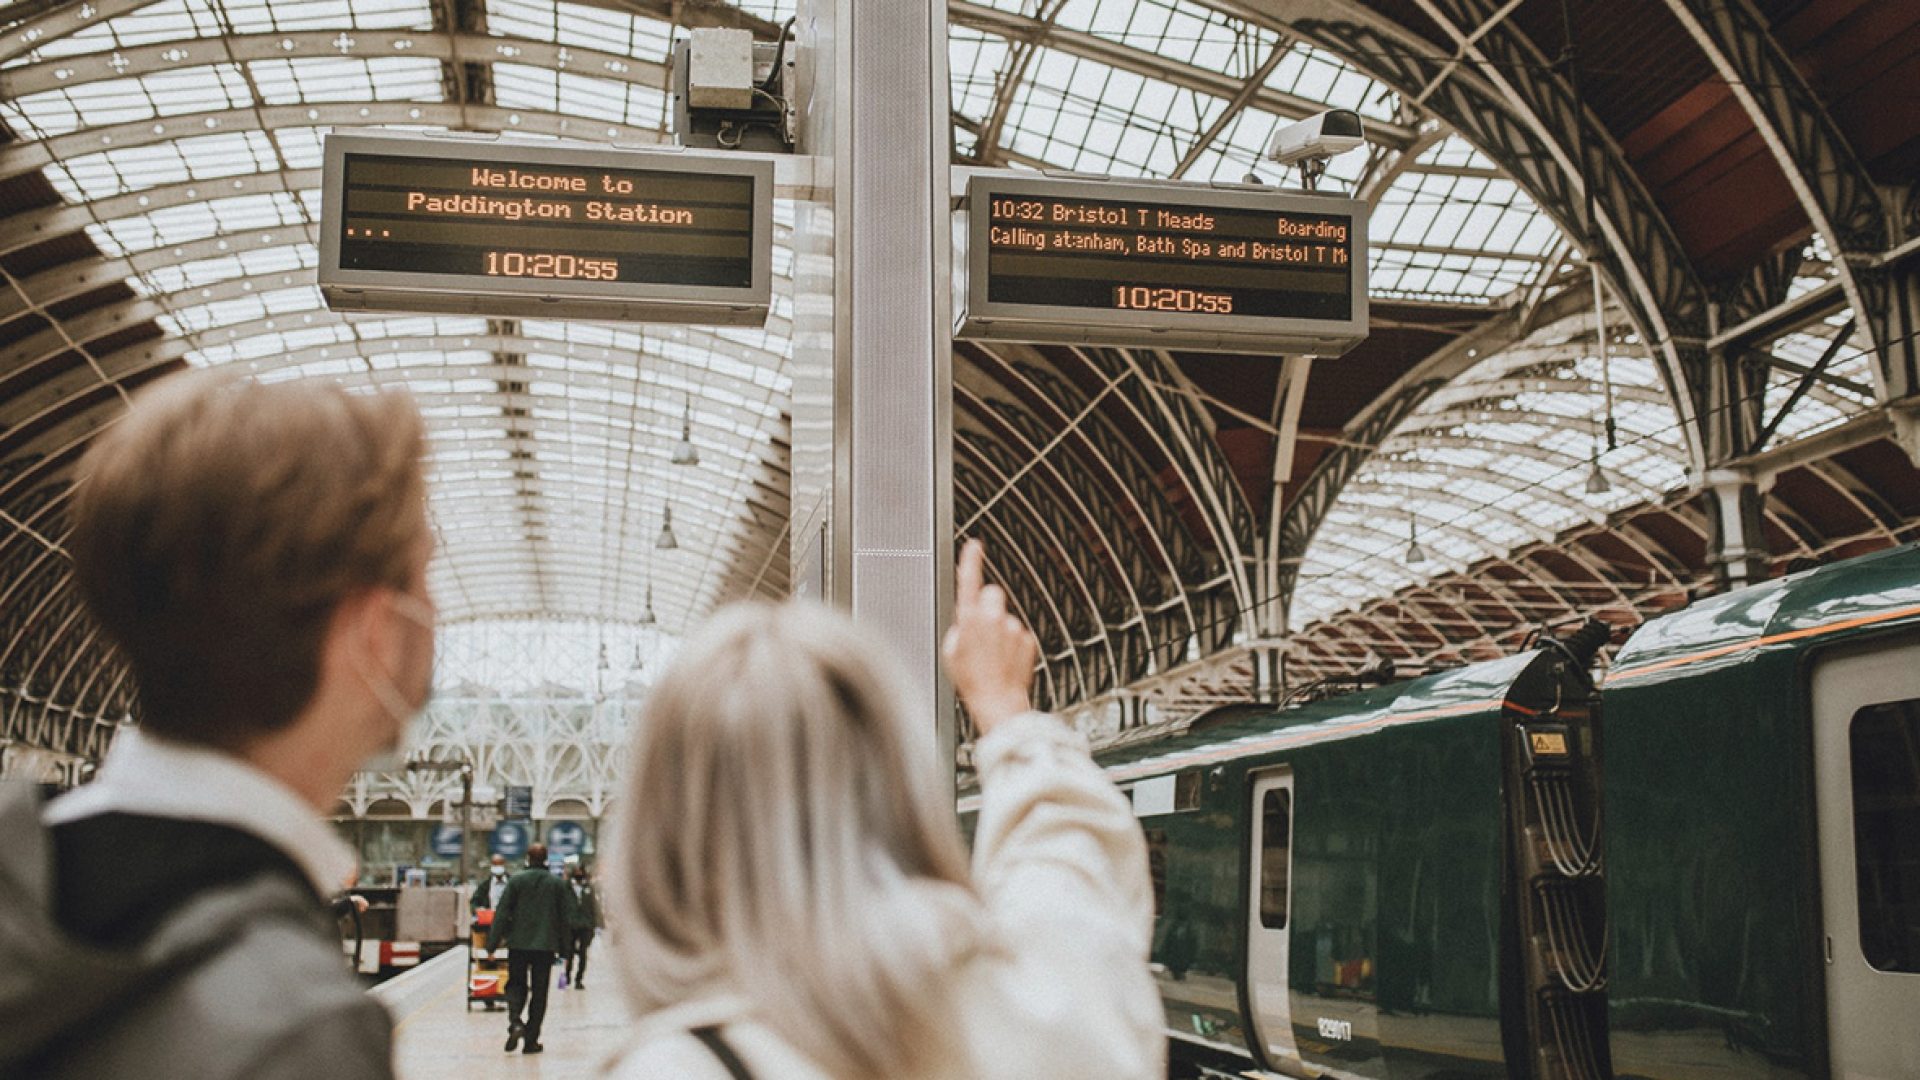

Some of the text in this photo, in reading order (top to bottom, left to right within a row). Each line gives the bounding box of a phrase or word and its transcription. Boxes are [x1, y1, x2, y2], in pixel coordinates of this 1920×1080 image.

[470, 167, 634, 195] Welcome to
[407, 191, 694, 225] Paddington Station
[991, 200, 1214, 231] 10:32 Bristol T Meads
[990, 226, 1046, 251] Calling
[1136, 235, 1175, 254] Bath
[1181, 238, 1211, 259] Spa
[1217, 242, 1246, 259] and
[1252, 241, 1308, 262] Bristol
[1314, 246, 1326, 263] T
[1278, 218, 1347, 243] Boarding
[486, 251, 619, 281] 10:20:55
[1116, 286, 1233, 313] 10:20:55
